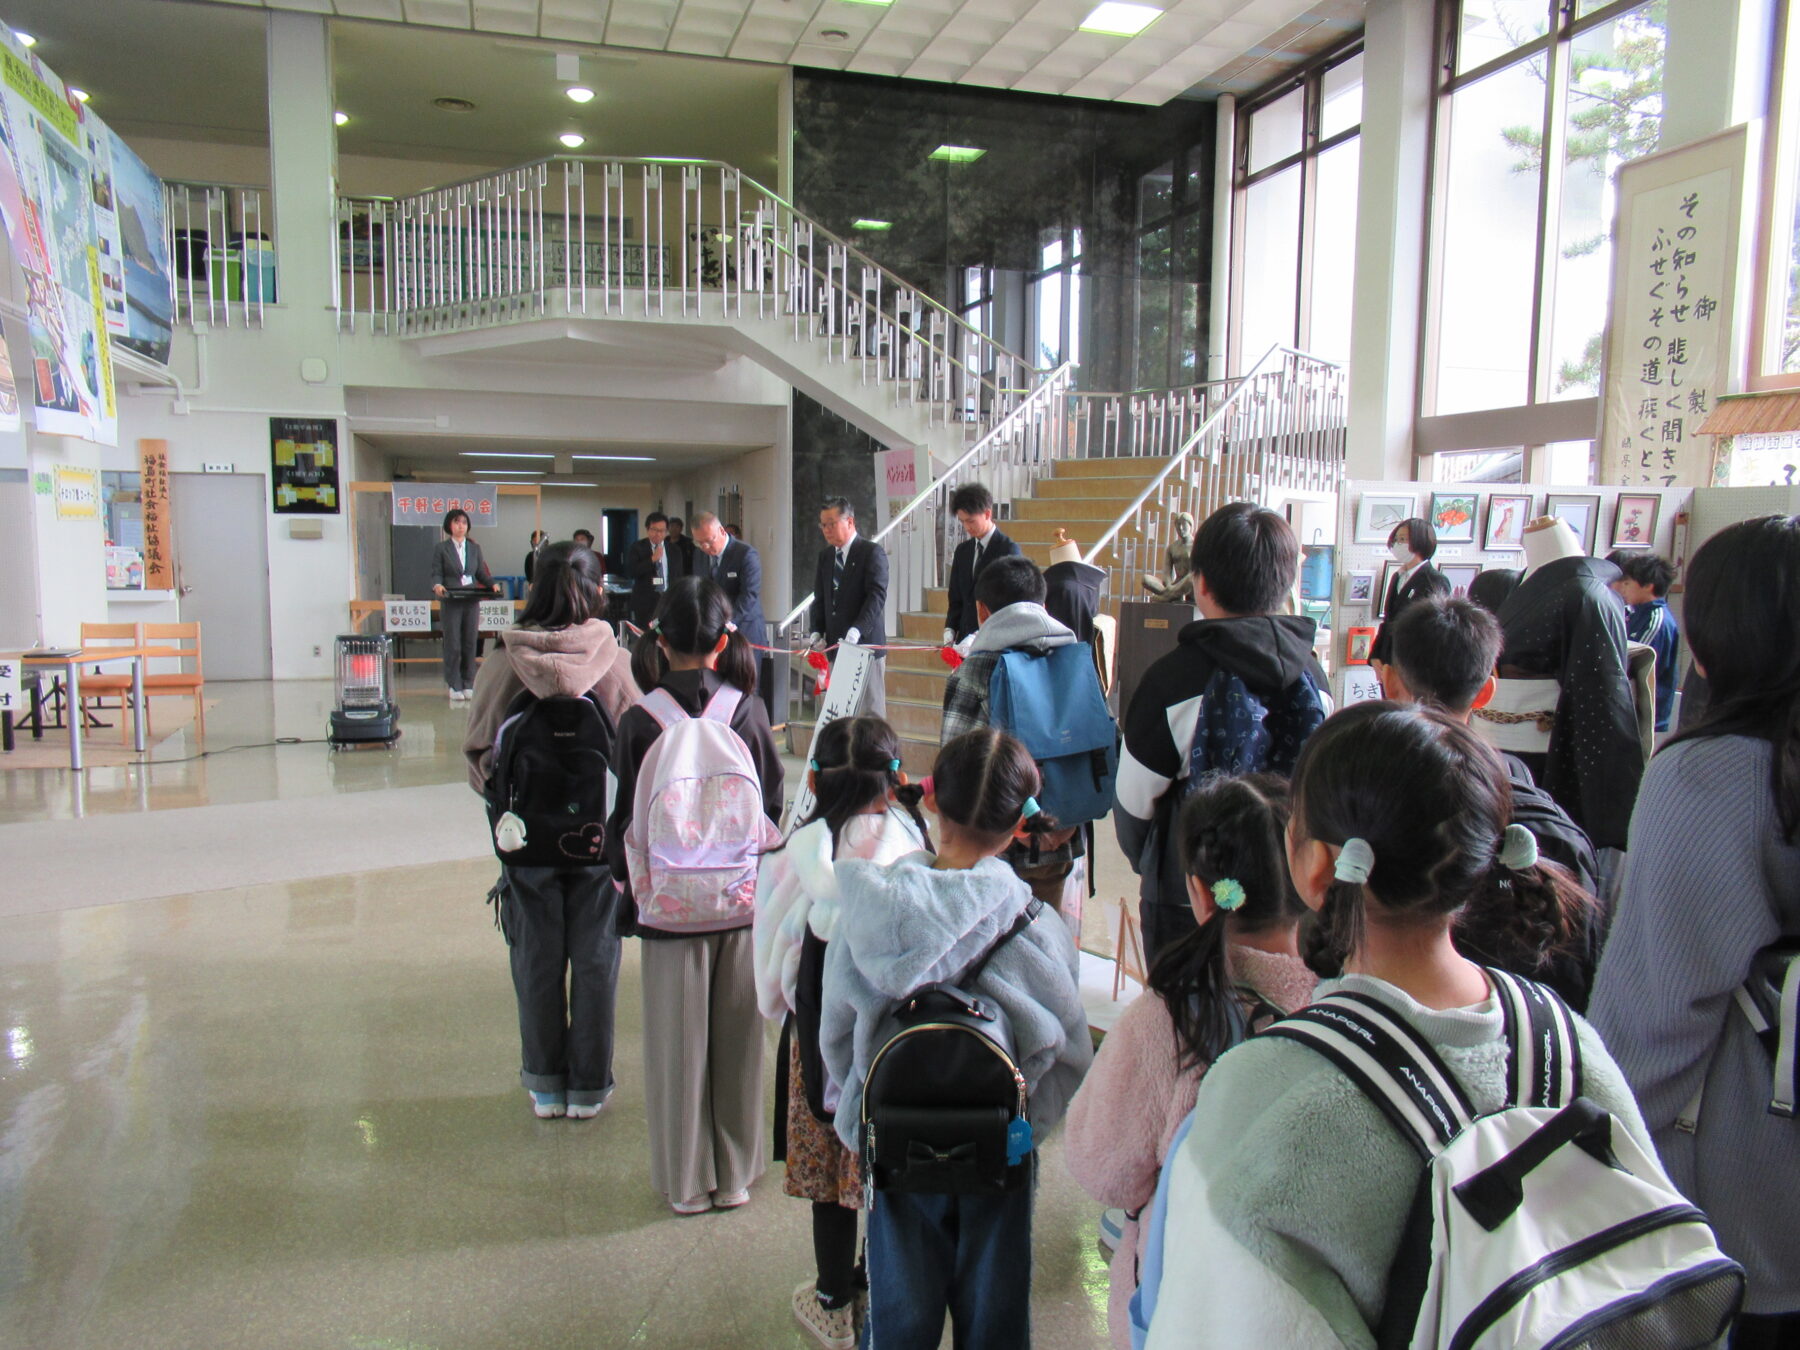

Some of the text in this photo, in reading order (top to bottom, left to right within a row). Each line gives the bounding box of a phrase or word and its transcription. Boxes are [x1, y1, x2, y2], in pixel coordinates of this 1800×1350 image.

[144, 455, 164, 575] 福島町社会福祉協議会
